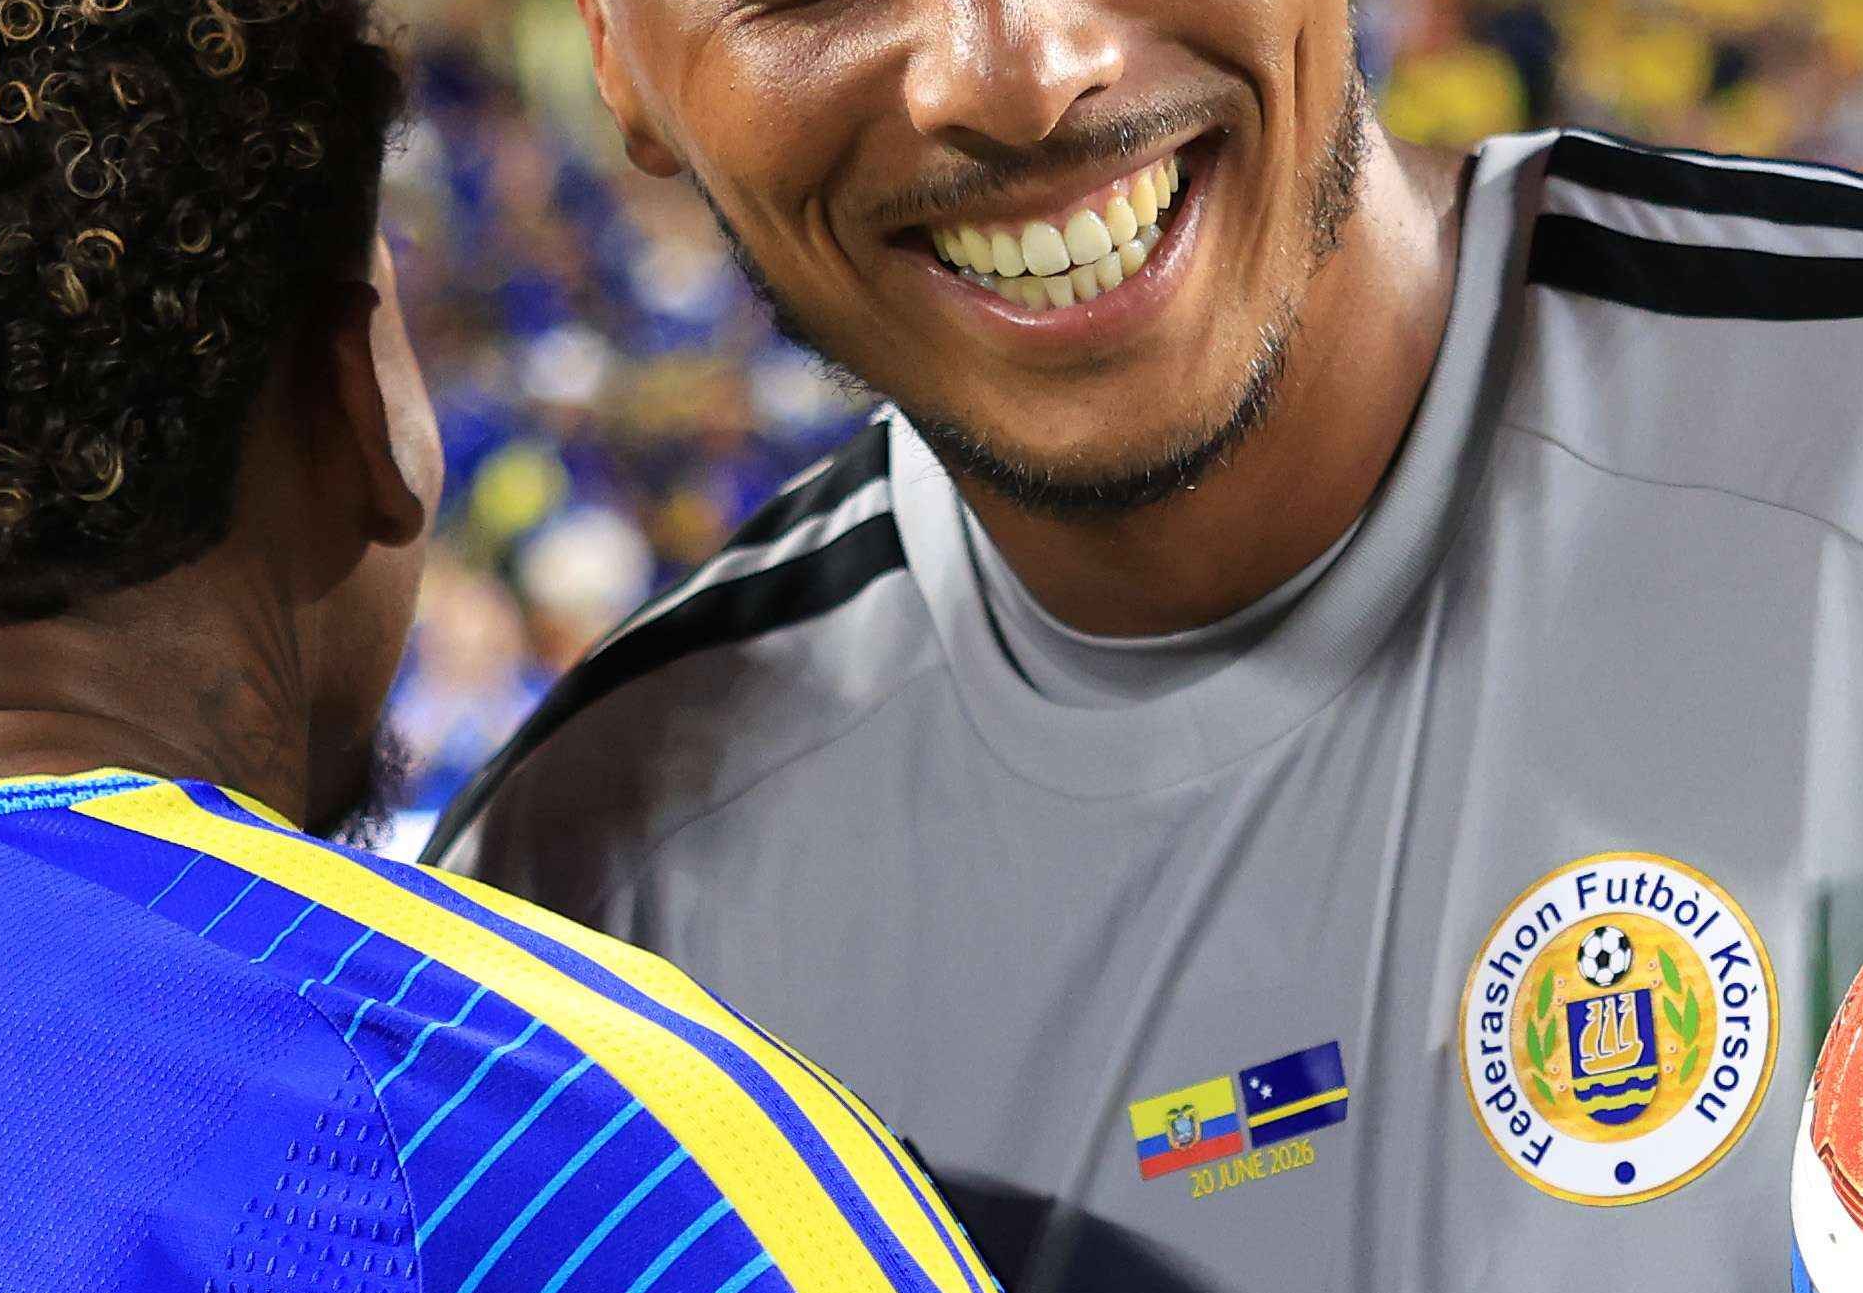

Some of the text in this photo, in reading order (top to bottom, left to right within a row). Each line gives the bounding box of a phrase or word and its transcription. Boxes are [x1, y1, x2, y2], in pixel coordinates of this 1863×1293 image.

[1481, 871, 1758, 1168] Federashon Futbòl Kòrsou
[1191, 1139, 1316, 1199] 20 JUNE 2026
